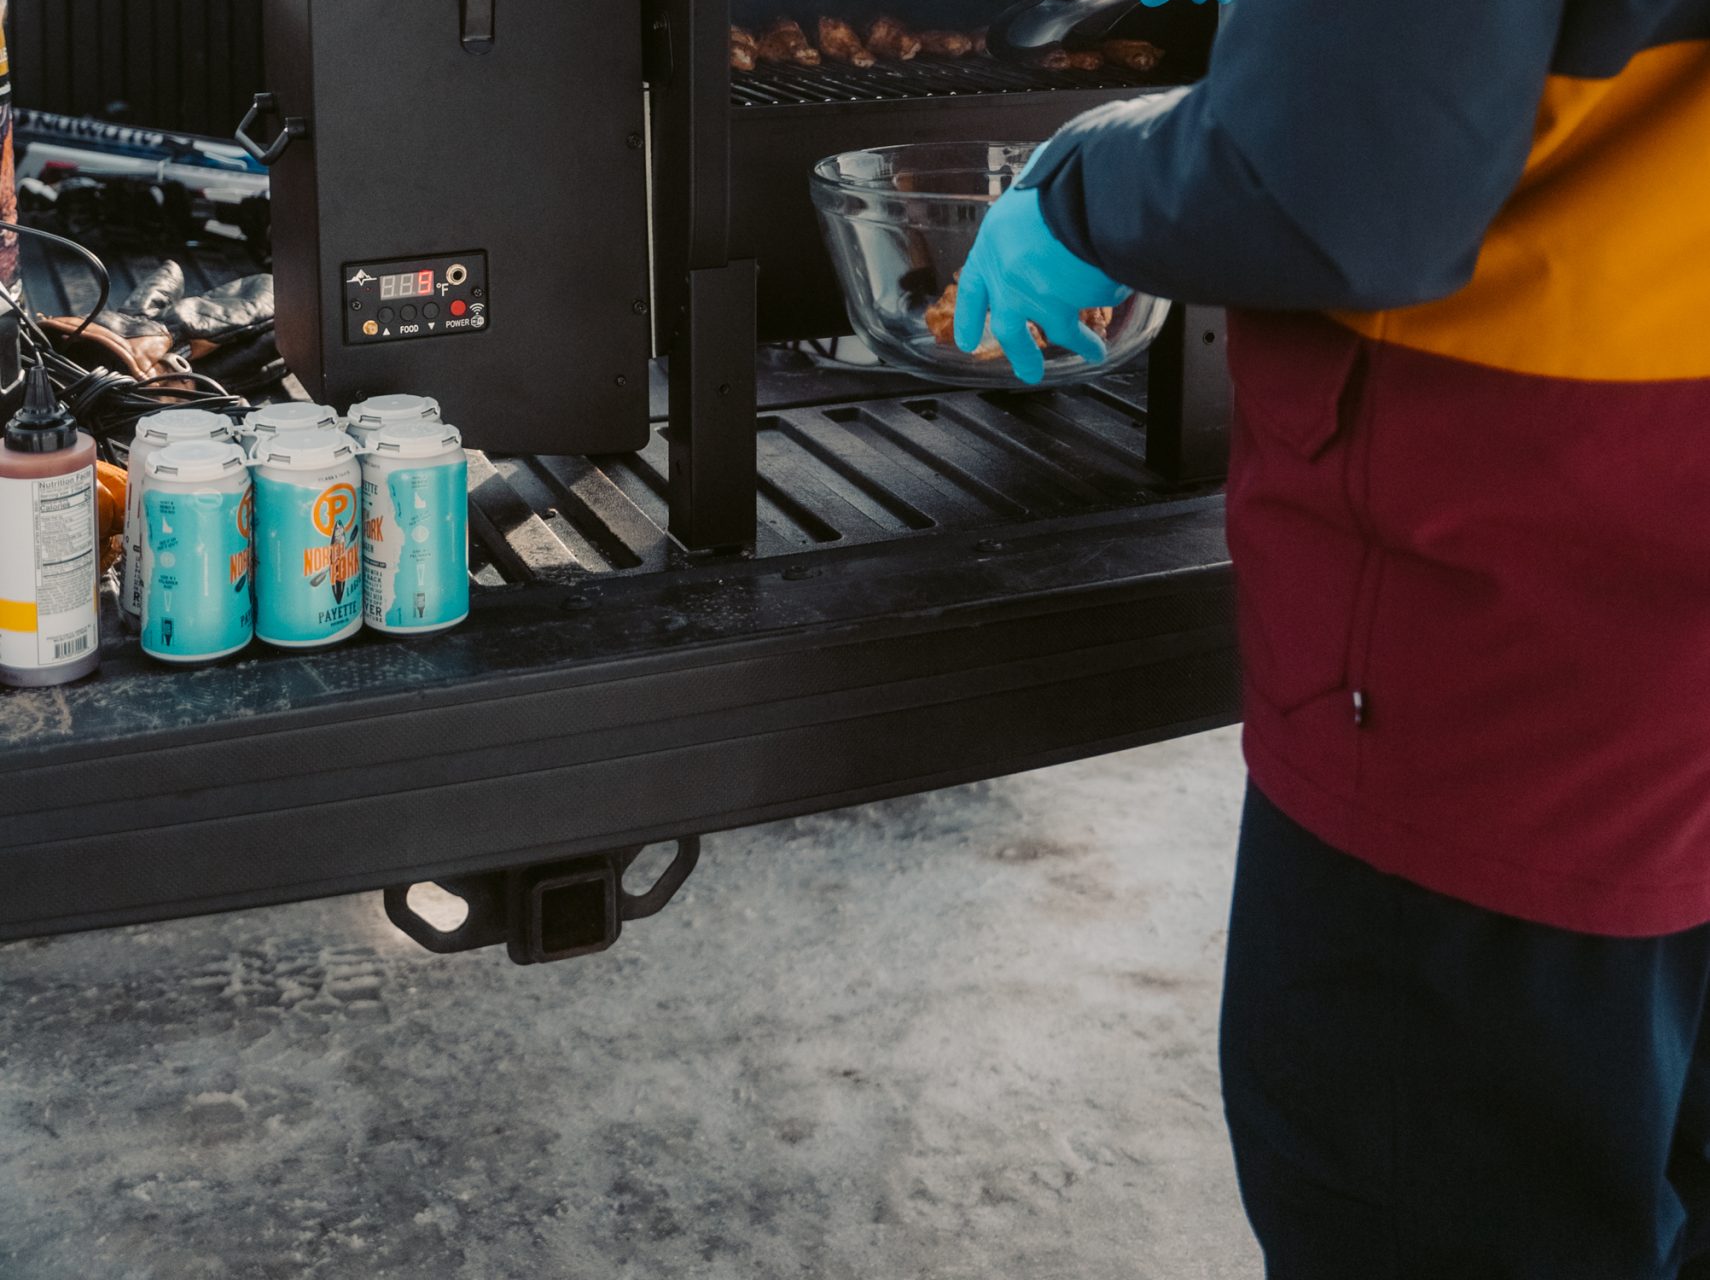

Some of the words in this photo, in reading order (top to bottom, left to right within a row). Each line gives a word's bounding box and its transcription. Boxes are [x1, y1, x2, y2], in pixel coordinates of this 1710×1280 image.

[445, 318, 470, 328] POWER
[400, 324, 419, 334] FOOD
[40, 477, 75, 489] Nutrition
[319, 601, 357, 624] PAYETTE
